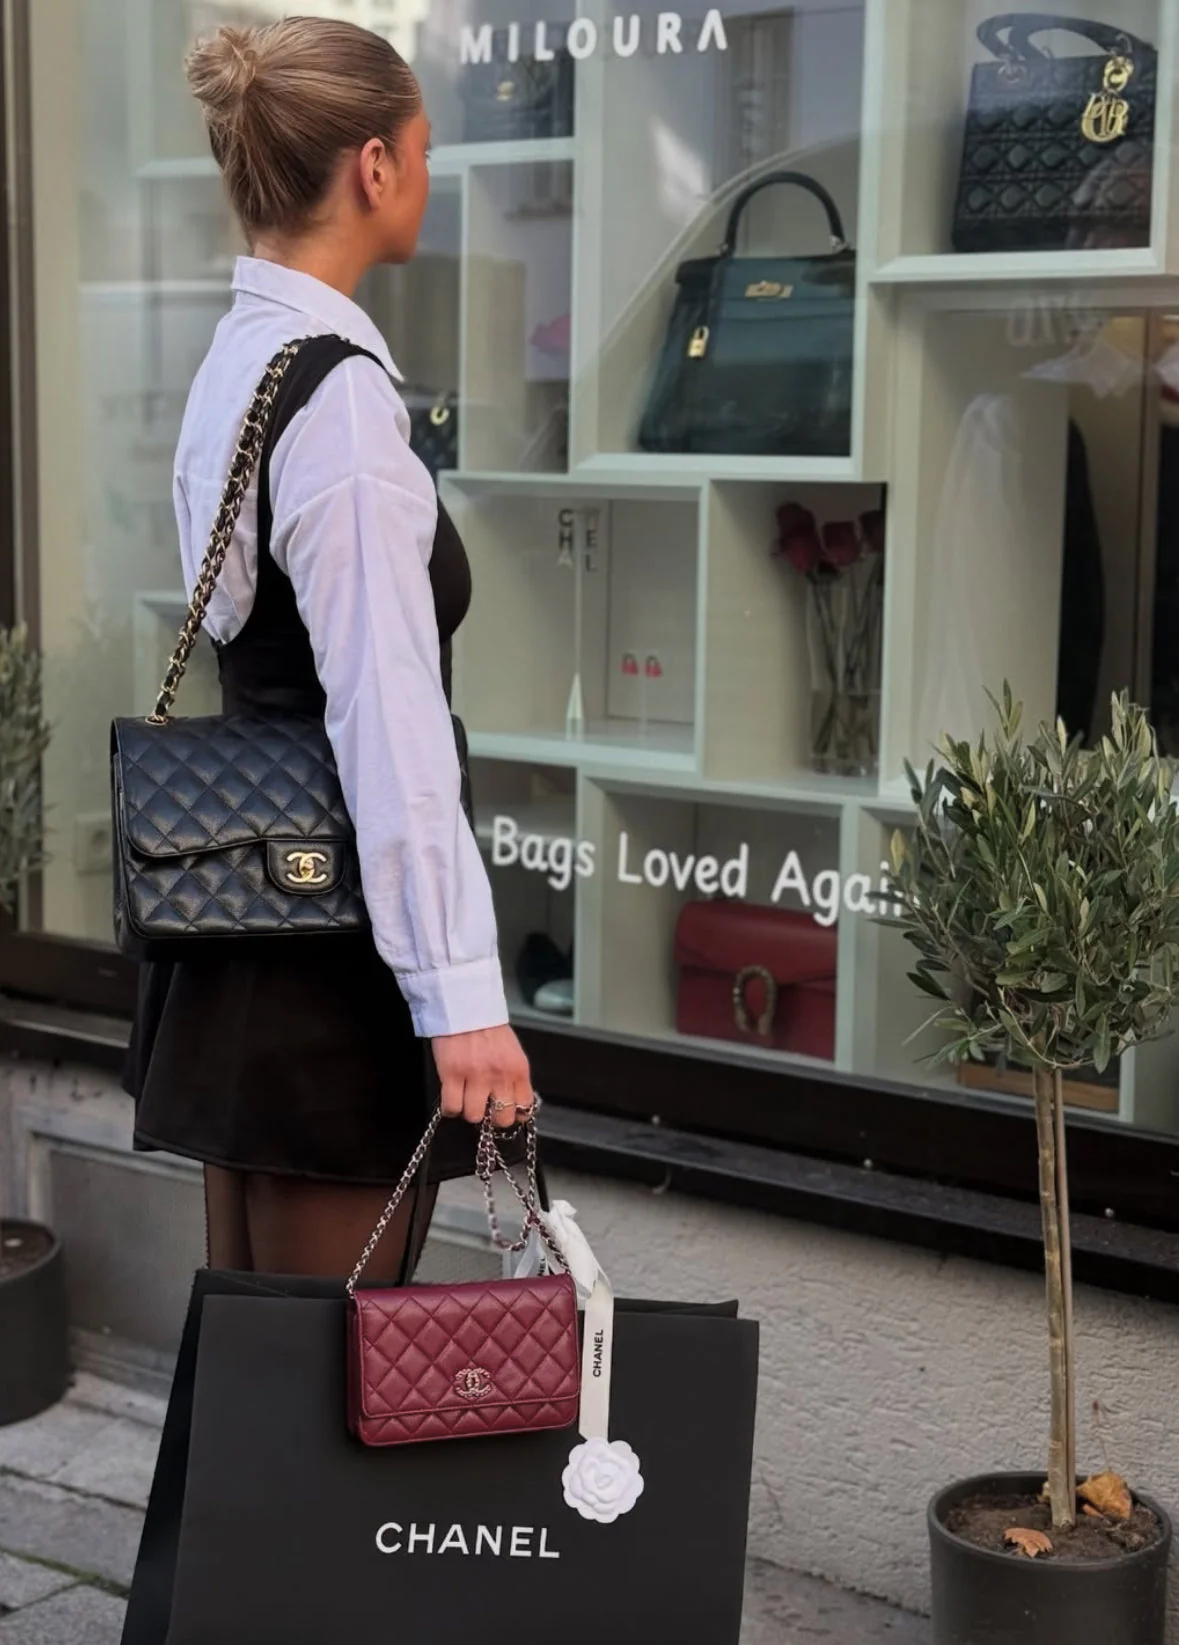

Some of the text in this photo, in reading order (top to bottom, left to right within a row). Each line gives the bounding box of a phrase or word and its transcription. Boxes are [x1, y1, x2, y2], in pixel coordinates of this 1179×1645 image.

[492, 815, 596, 892] Bags
[618, 831, 749, 898] Loved
[592, 1328, 605, 1378] CHANEL
[375, 1521, 560, 1559] CHANEL
